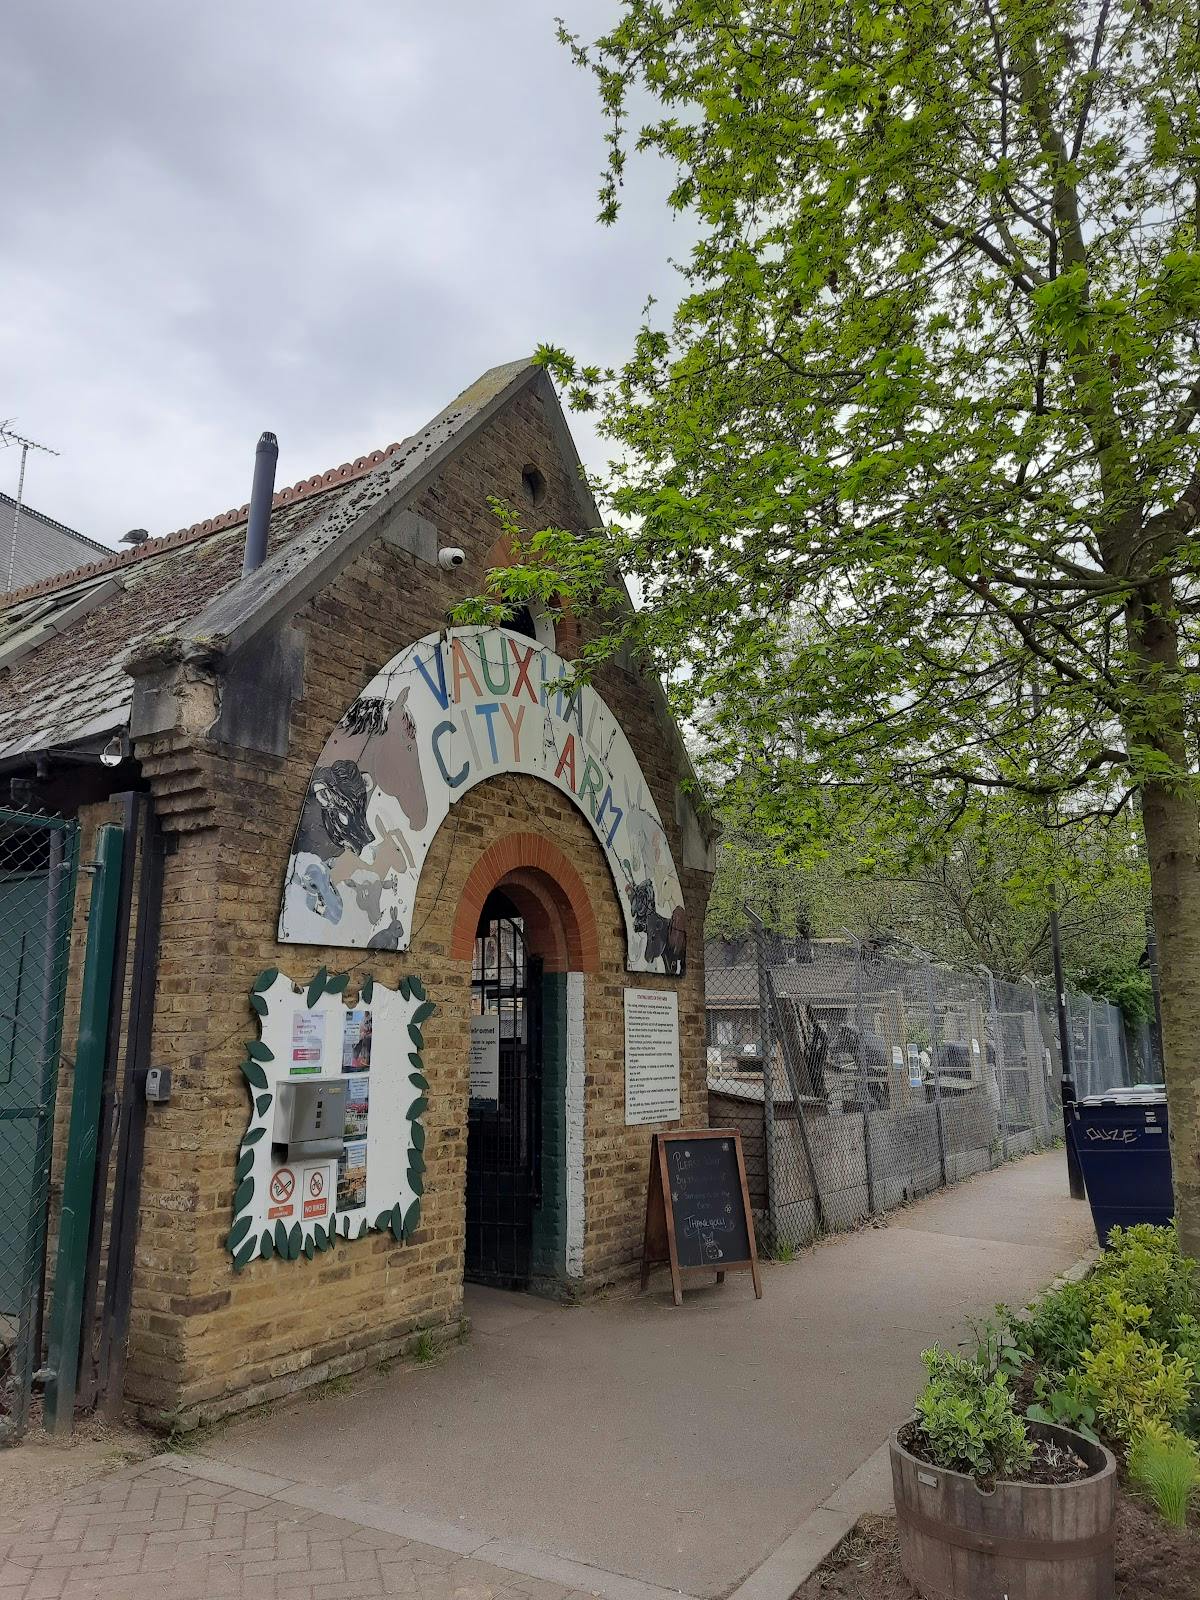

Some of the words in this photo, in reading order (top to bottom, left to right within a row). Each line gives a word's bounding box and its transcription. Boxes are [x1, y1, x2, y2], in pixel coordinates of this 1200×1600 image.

[413, 636, 617, 781] VAUXHALL
[431, 702, 525, 789] CITY
[312, 1203, 325, 1211] BIKES
